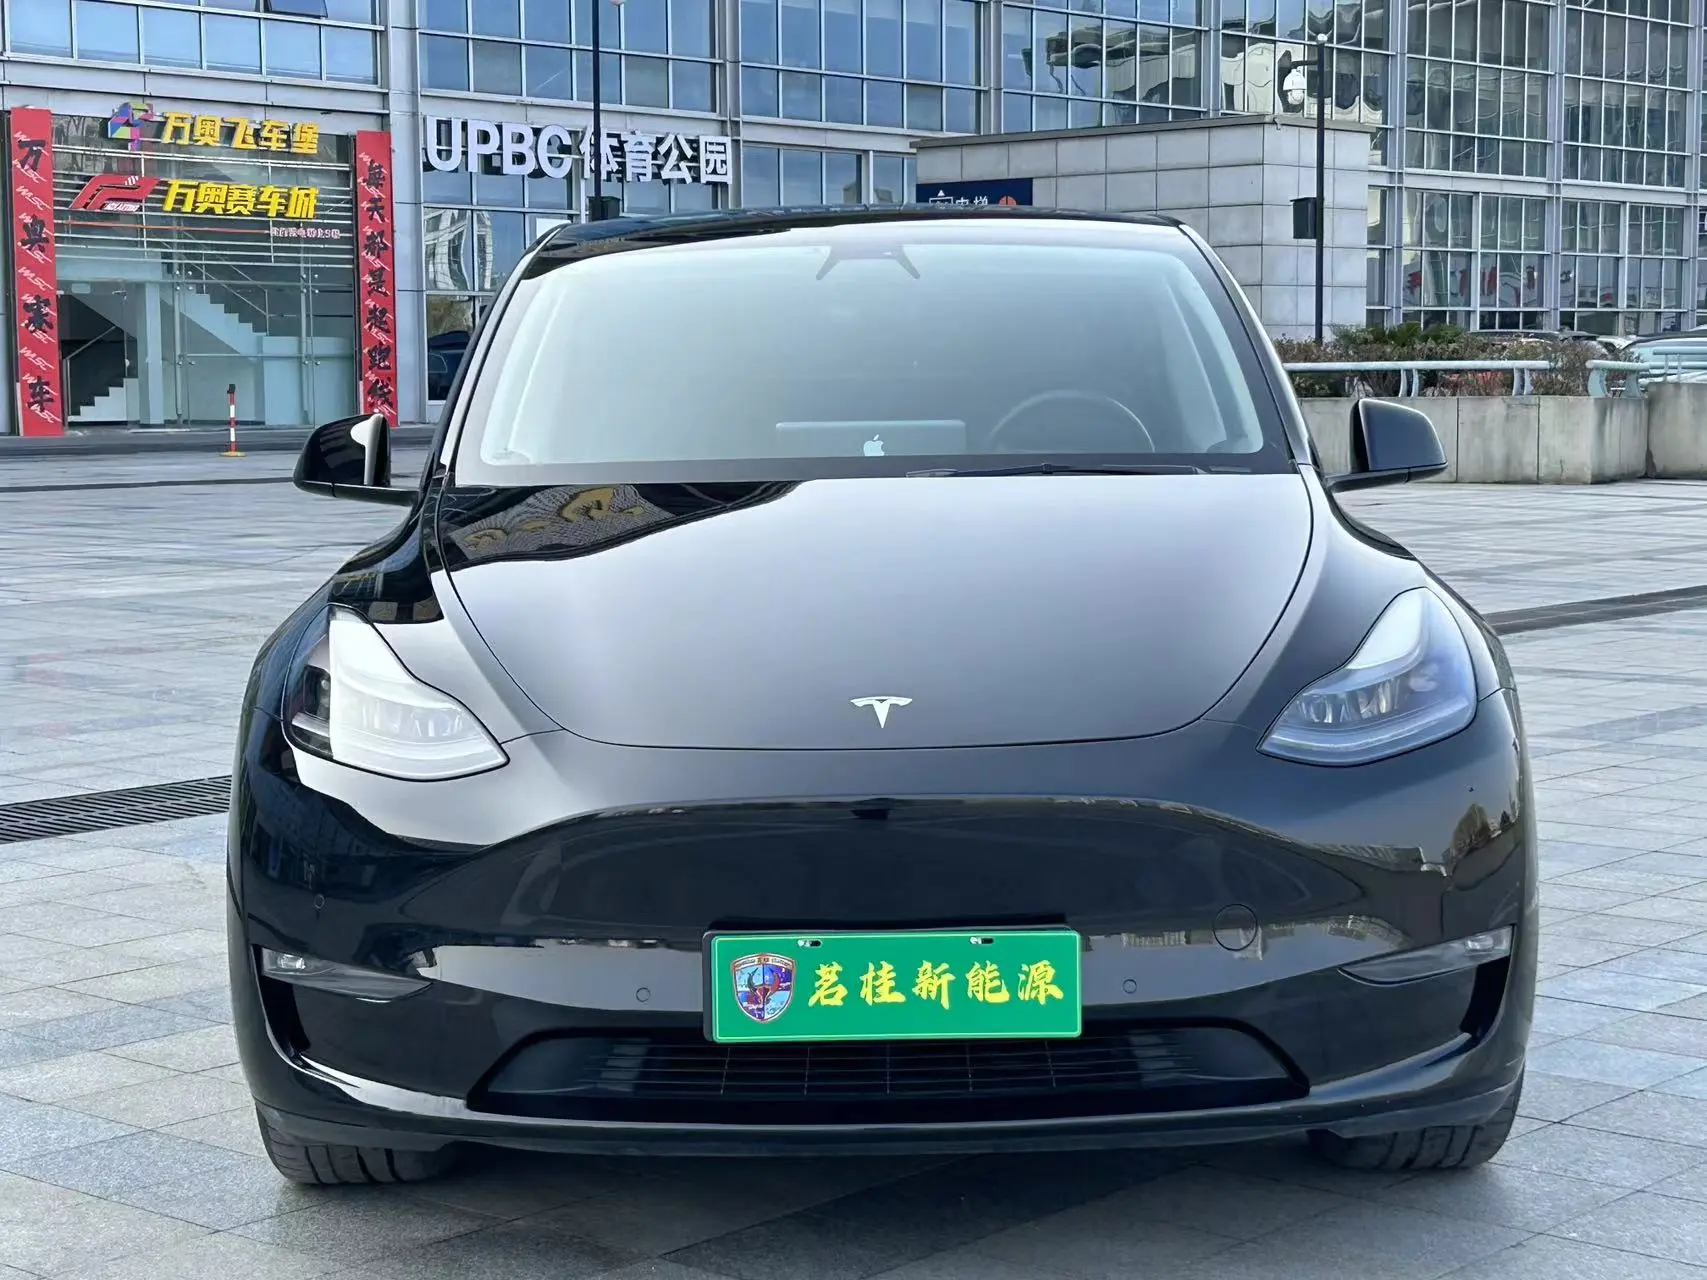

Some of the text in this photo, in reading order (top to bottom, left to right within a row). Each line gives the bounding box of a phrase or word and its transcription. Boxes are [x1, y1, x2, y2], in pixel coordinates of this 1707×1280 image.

[161, 112, 320, 154] 万奥飞车堡
[426, 115, 733, 185] UPBC 体育公园
[162, 178, 320, 219] 万奥赛车城
[808, 959, 1065, 1010] 茗桂新能源
